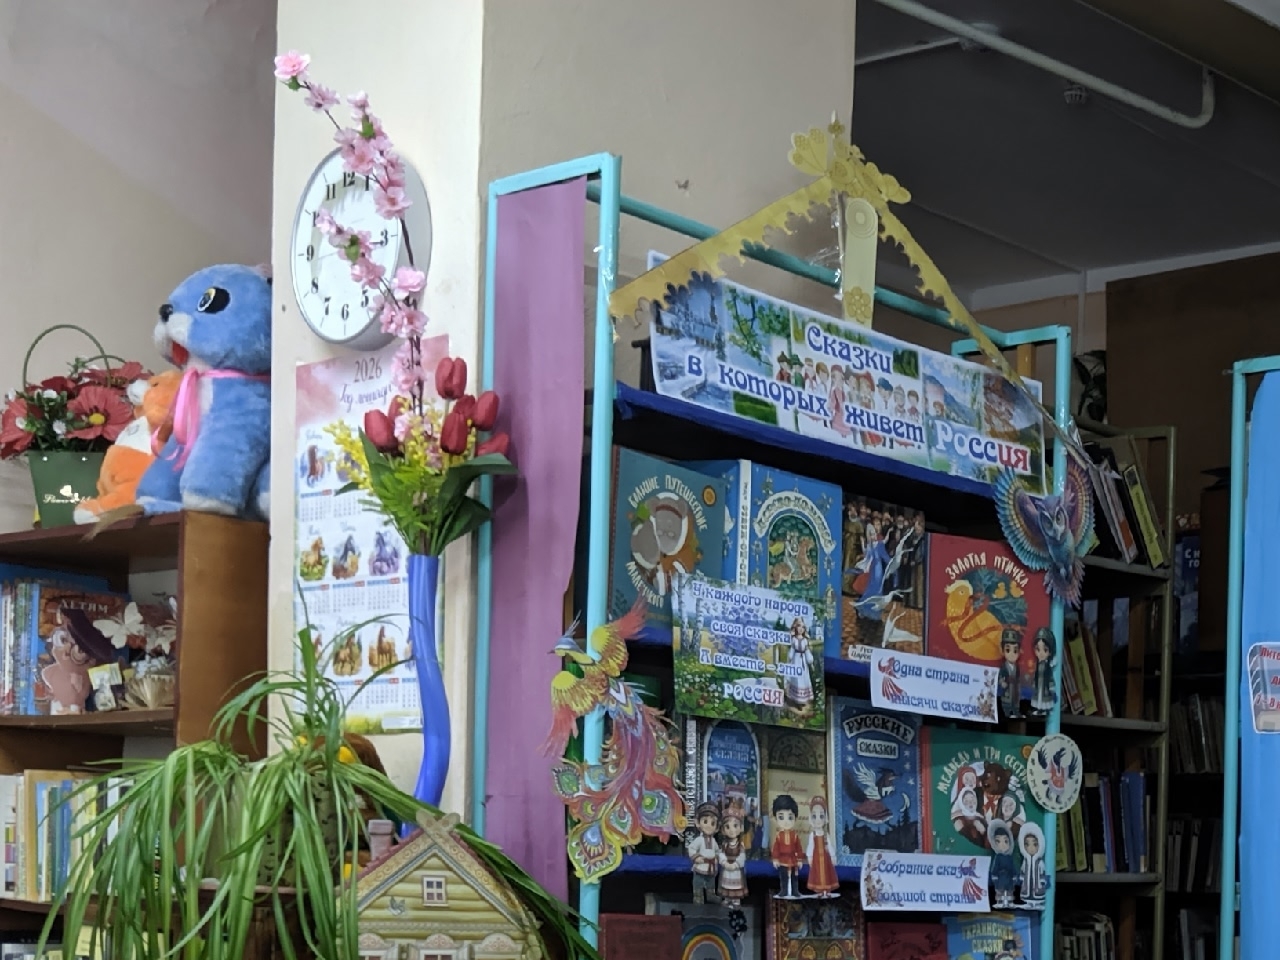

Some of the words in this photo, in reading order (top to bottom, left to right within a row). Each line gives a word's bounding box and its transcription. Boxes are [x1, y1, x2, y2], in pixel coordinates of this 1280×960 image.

[306, 245, 315, 262] 9
[311, 278, 319, 294] 8
[324, 297, 332, 316] 7
[341, 304, 349, 321] 6
[806, 322, 893, 376] Сказки
[353, 357, 383, 383] 2026
[686, 353, 703, 377] в
[718, 363, 830, 418] которых
[845, 406, 925, 446] живет
[935, 421, 1031, 472] Россия
[945, 552, 987, 580] ЗОЛОТАЯ
[993, 556, 1030, 587] ПТИЧКА
[704, 588, 762, 606] каждого
[765, 598, 809, 616] народа
[712, 621, 743, 635] своя
[746, 626, 791, 644] сказка
[714, 653, 765, 670] вместе
[779, 663, 804, 676] это
[892, 659, 922, 678] Одна
[925, 667, 970, 684] страна
[890, 694, 938, 710] тысячи
[941, 700, 982, 717] сказок
[845, 714, 913, 743] РУССКИЕ
[859, 741, 897, 756] СКАЗКИ
[984, 745, 1001, 761] ТРИ
[877, 859, 934, 877] Собрание
[877, 889, 926, 904] большой
[972, 939, 1003, 953] СКАЗКИ
